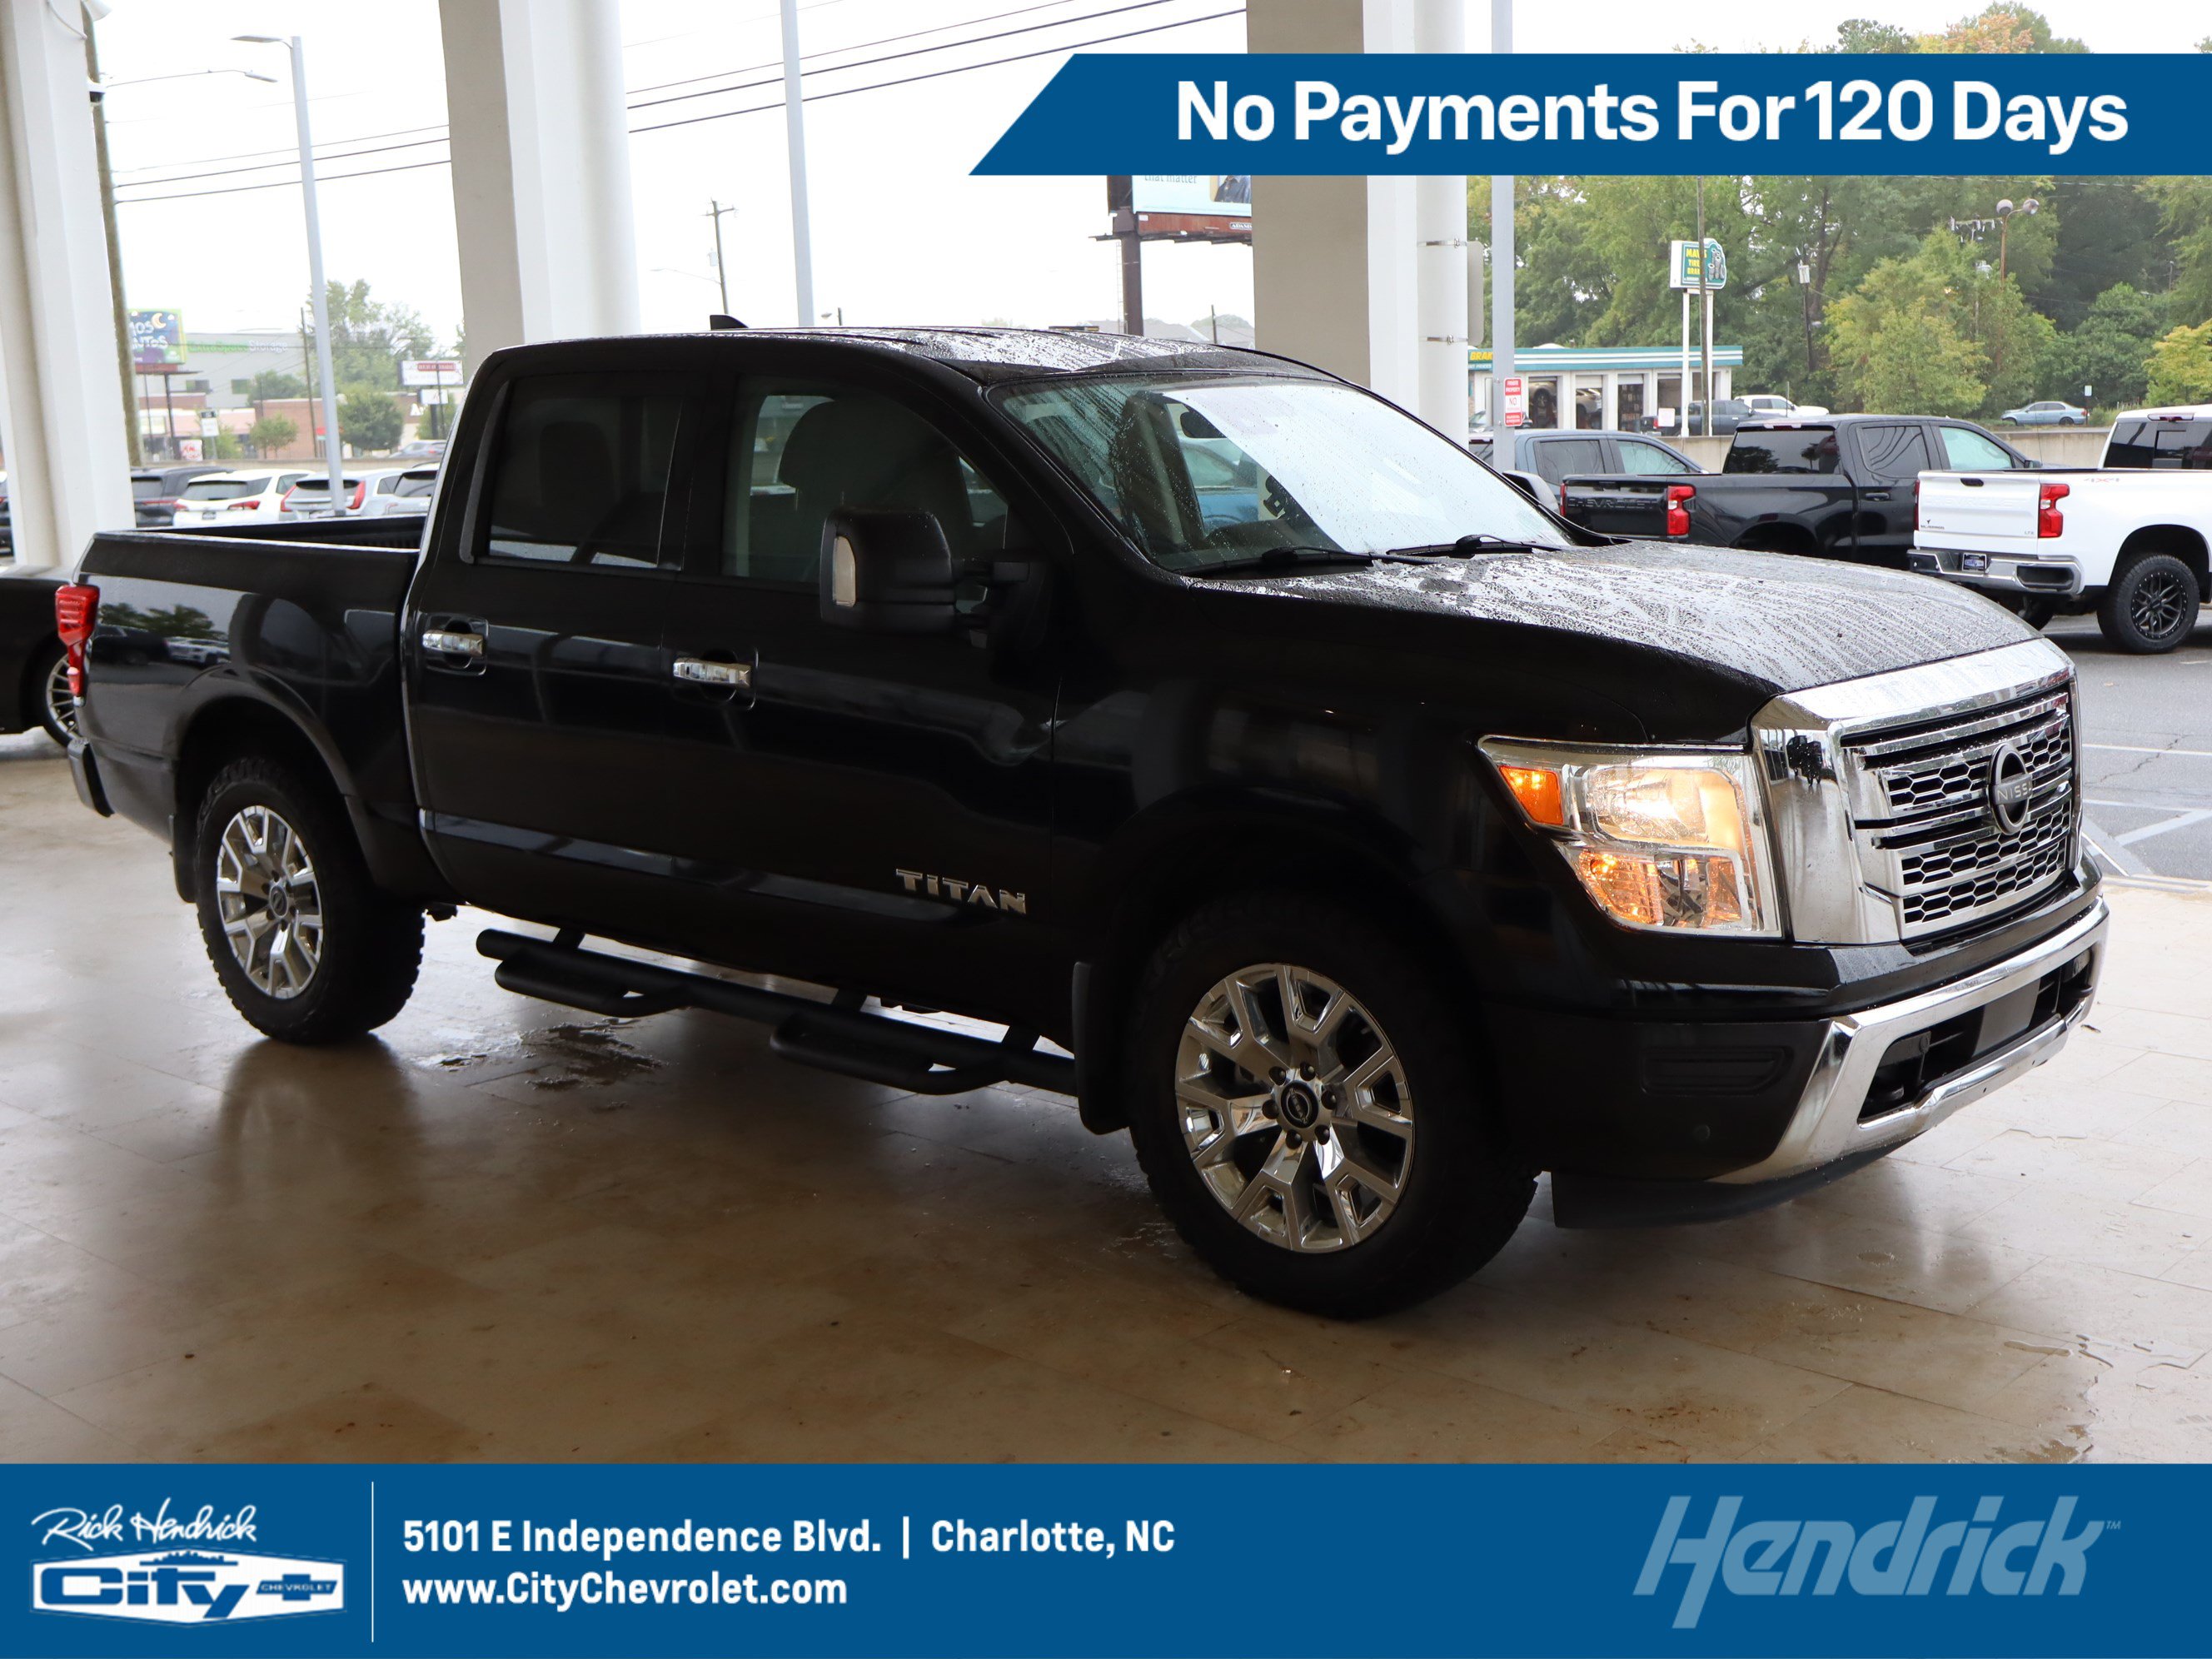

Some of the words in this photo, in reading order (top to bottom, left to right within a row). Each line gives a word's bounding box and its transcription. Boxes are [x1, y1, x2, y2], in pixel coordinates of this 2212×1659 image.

[1509, 397, 1517, 406] NO
[1567, 498, 1657, 510] CHEVROLET
[1997, 780, 2032, 800] NISS
[895, 868, 1027, 914] TITAN
